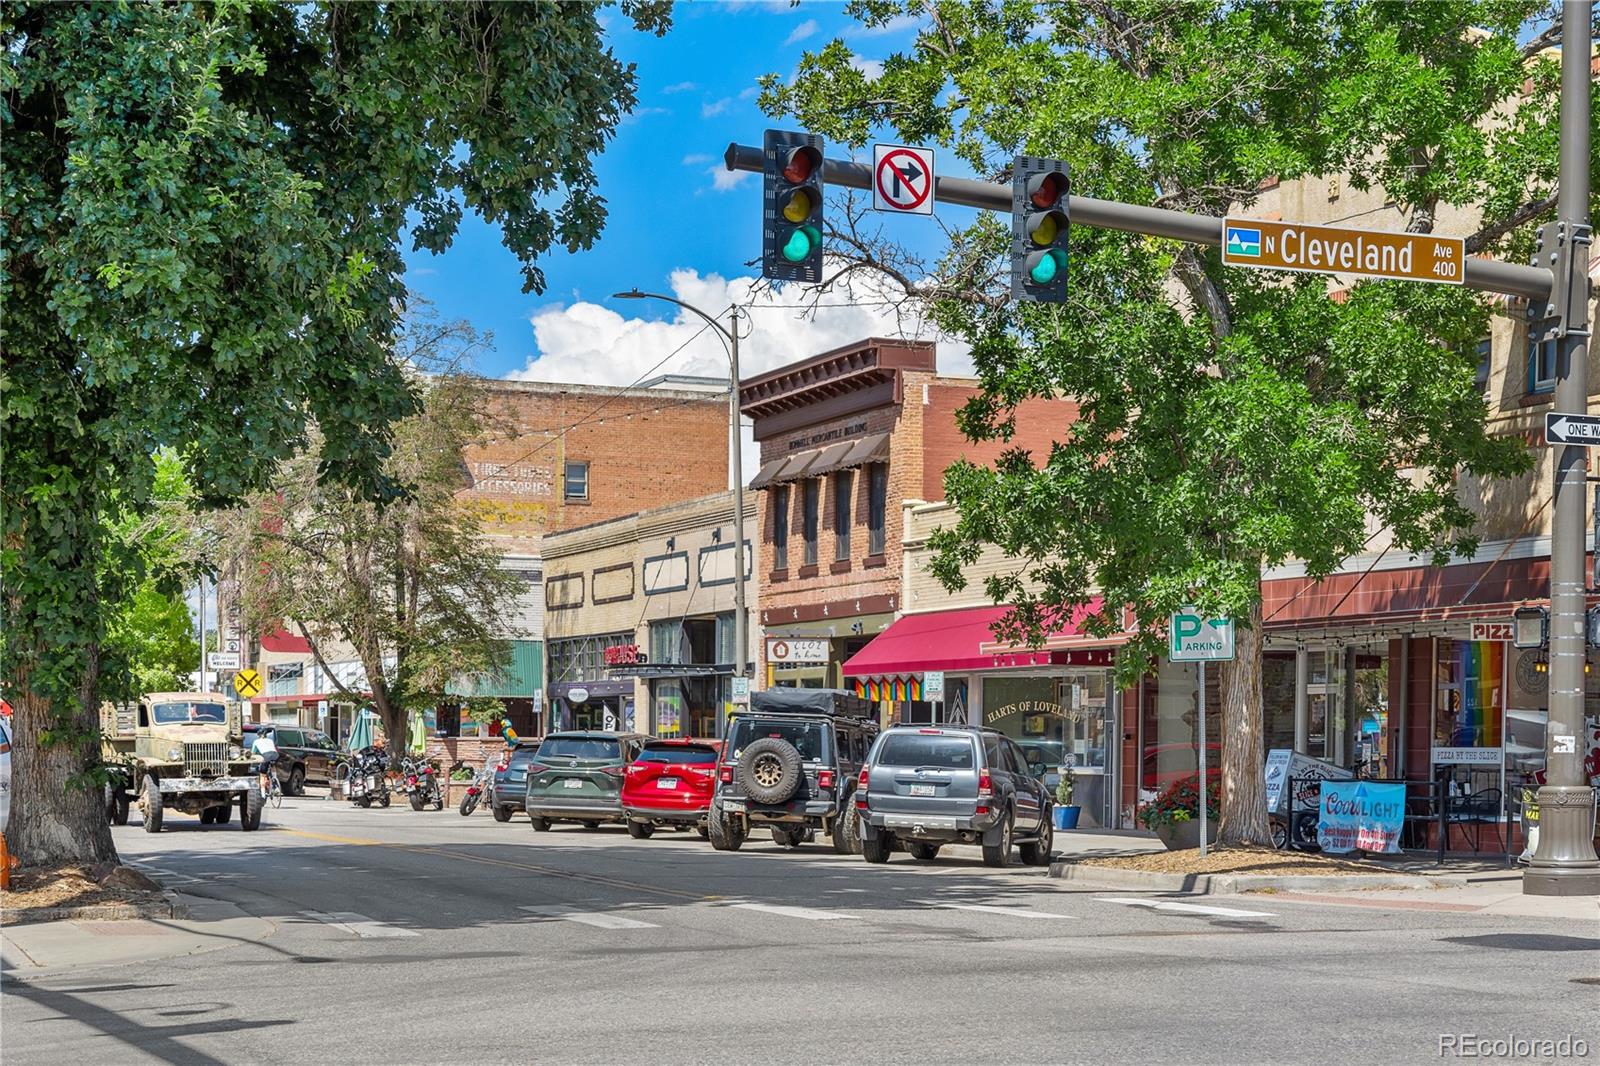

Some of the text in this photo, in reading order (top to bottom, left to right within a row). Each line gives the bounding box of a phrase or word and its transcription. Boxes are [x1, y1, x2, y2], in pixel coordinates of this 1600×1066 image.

[1265, 229, 1453, 274] N Cleveland Ave
[1432, 261, 1456, 278] 400
[844, 422, 868, 436] BUILDING
[1568, 423, 1588, 436] ONE
[1473, 624, 1513, 640] PIZZ
[237, 679, 260, 687] R R
[987, 700, 1081, 724] HARTS OF LOVELAND
[1437, 751, 1498, 760] PIZZA BY THE SLICE
[1320, 765, 1335, 777] SLICE
[1298, 789, 1314, 799] SLICE
[1361, 800, 1399, 818] LIGHT
